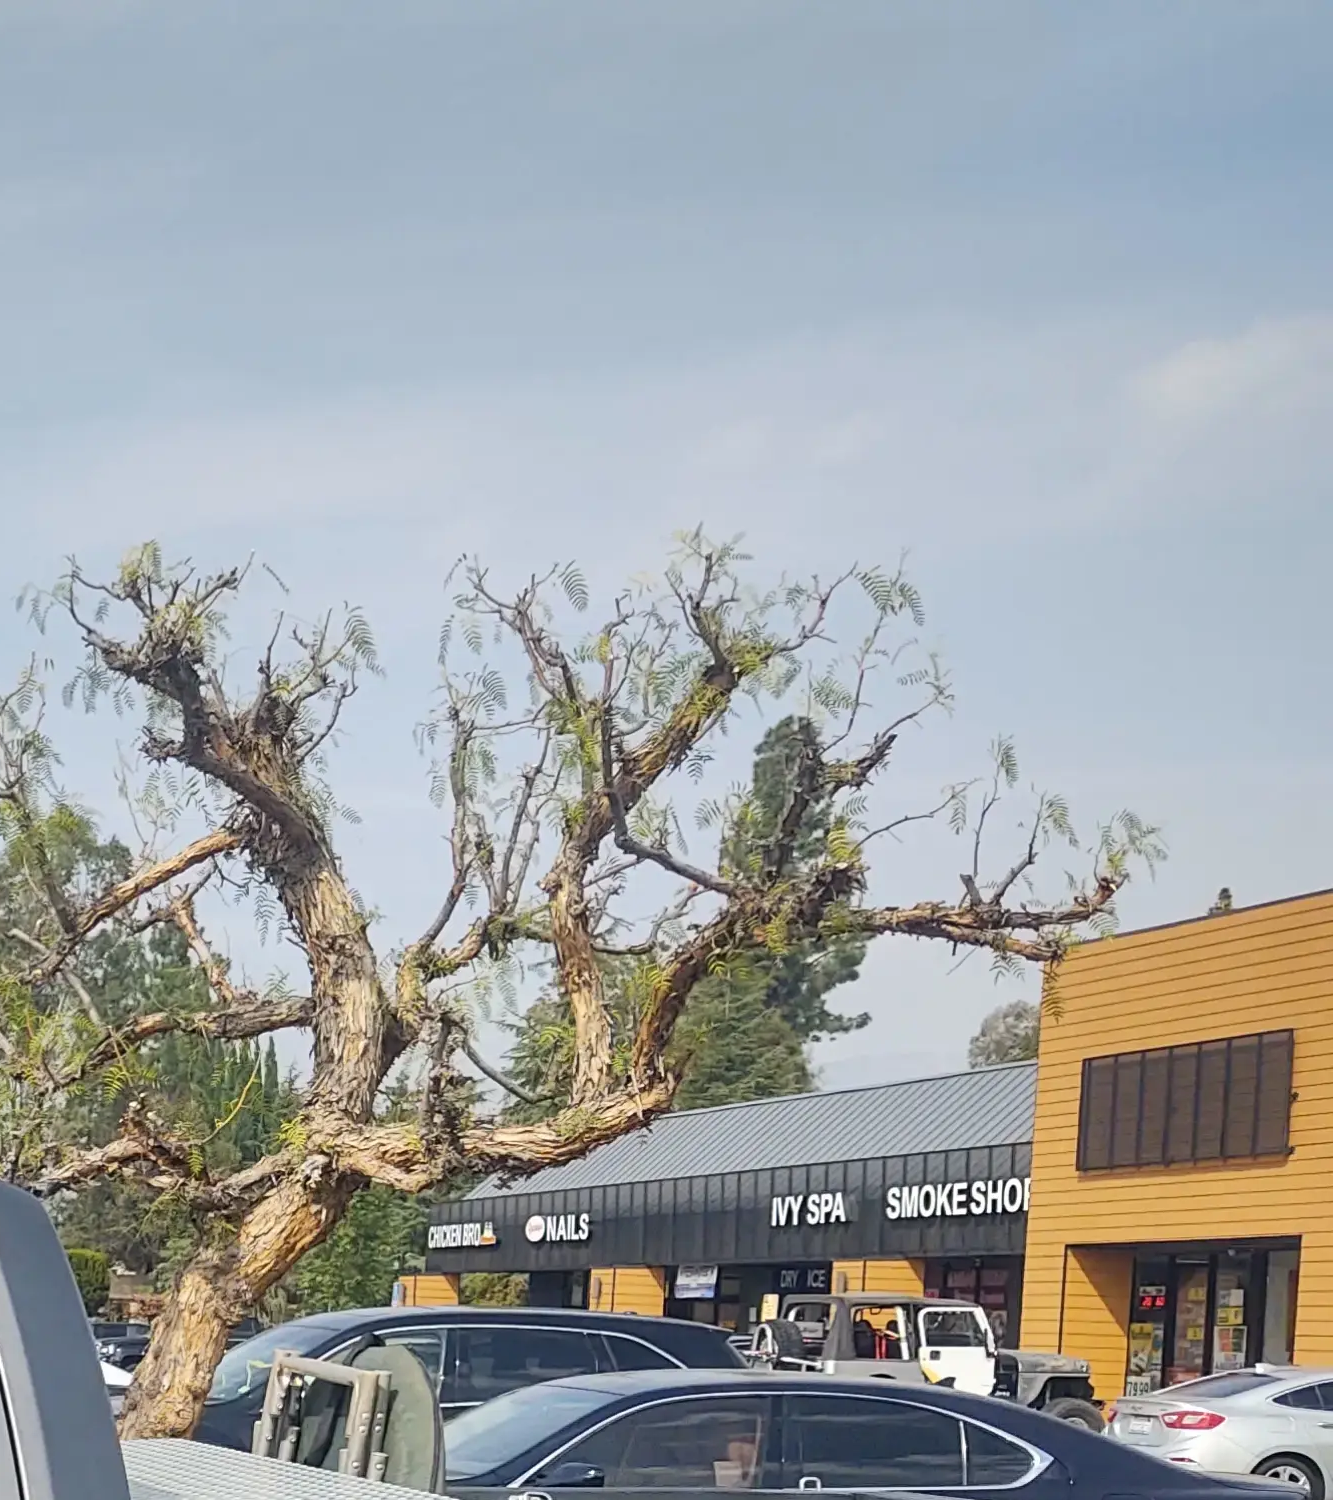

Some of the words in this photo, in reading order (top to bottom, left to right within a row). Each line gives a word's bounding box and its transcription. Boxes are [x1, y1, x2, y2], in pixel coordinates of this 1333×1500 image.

[771, 1195, 803, 1226] IVY
[806, 1192, 846, 1224] SPA
[886, 1182, 968, 1220] SMOKE
[428, 1224, 462, 1249] CHICKEN
[462, 1223, 481, 1246] BRO
[546, 1213, 589, 1241] NAILS
[780, 1270, 800, 1288] DRY
[807, 1269, 826, 1288] ICE
